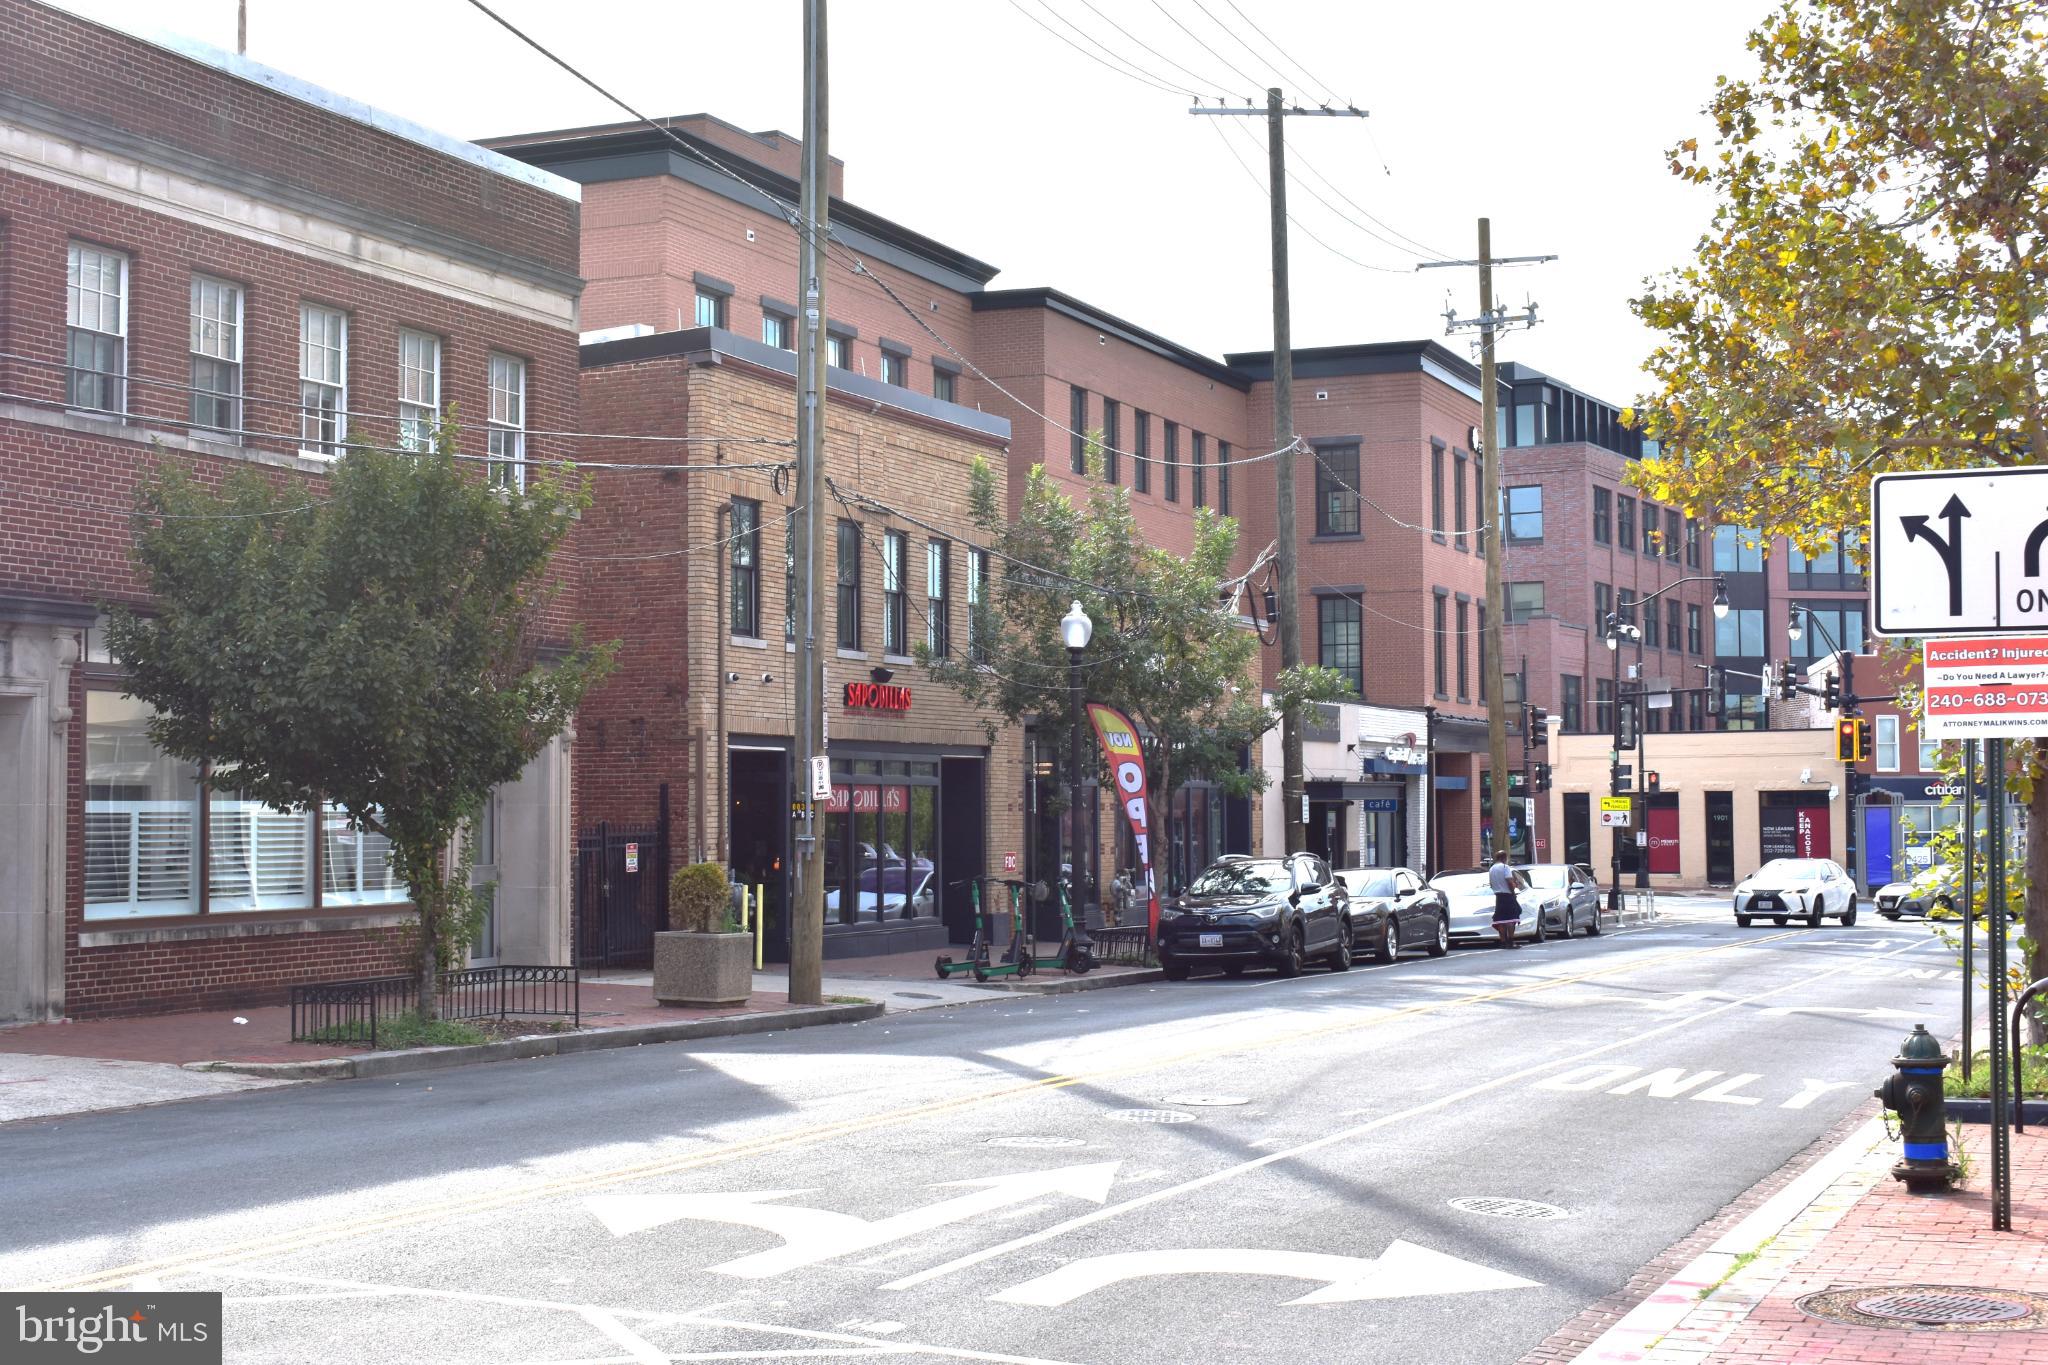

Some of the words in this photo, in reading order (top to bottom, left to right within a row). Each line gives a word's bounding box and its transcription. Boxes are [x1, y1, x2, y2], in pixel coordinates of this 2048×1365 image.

[1930, 648, 1998, 661] Accident?
[1975, 672, 1998, 680] Need
[1943, 719, 2048, 727] ATTORNEYMALIKWINS.COM
[1924, 784, 1966, 796] citiban
[1804, 817, 1812, 859] ANACOST
[1005, 856, 1015, 867] FDC
[1529, 1064, 1864, 1110] ONLY
